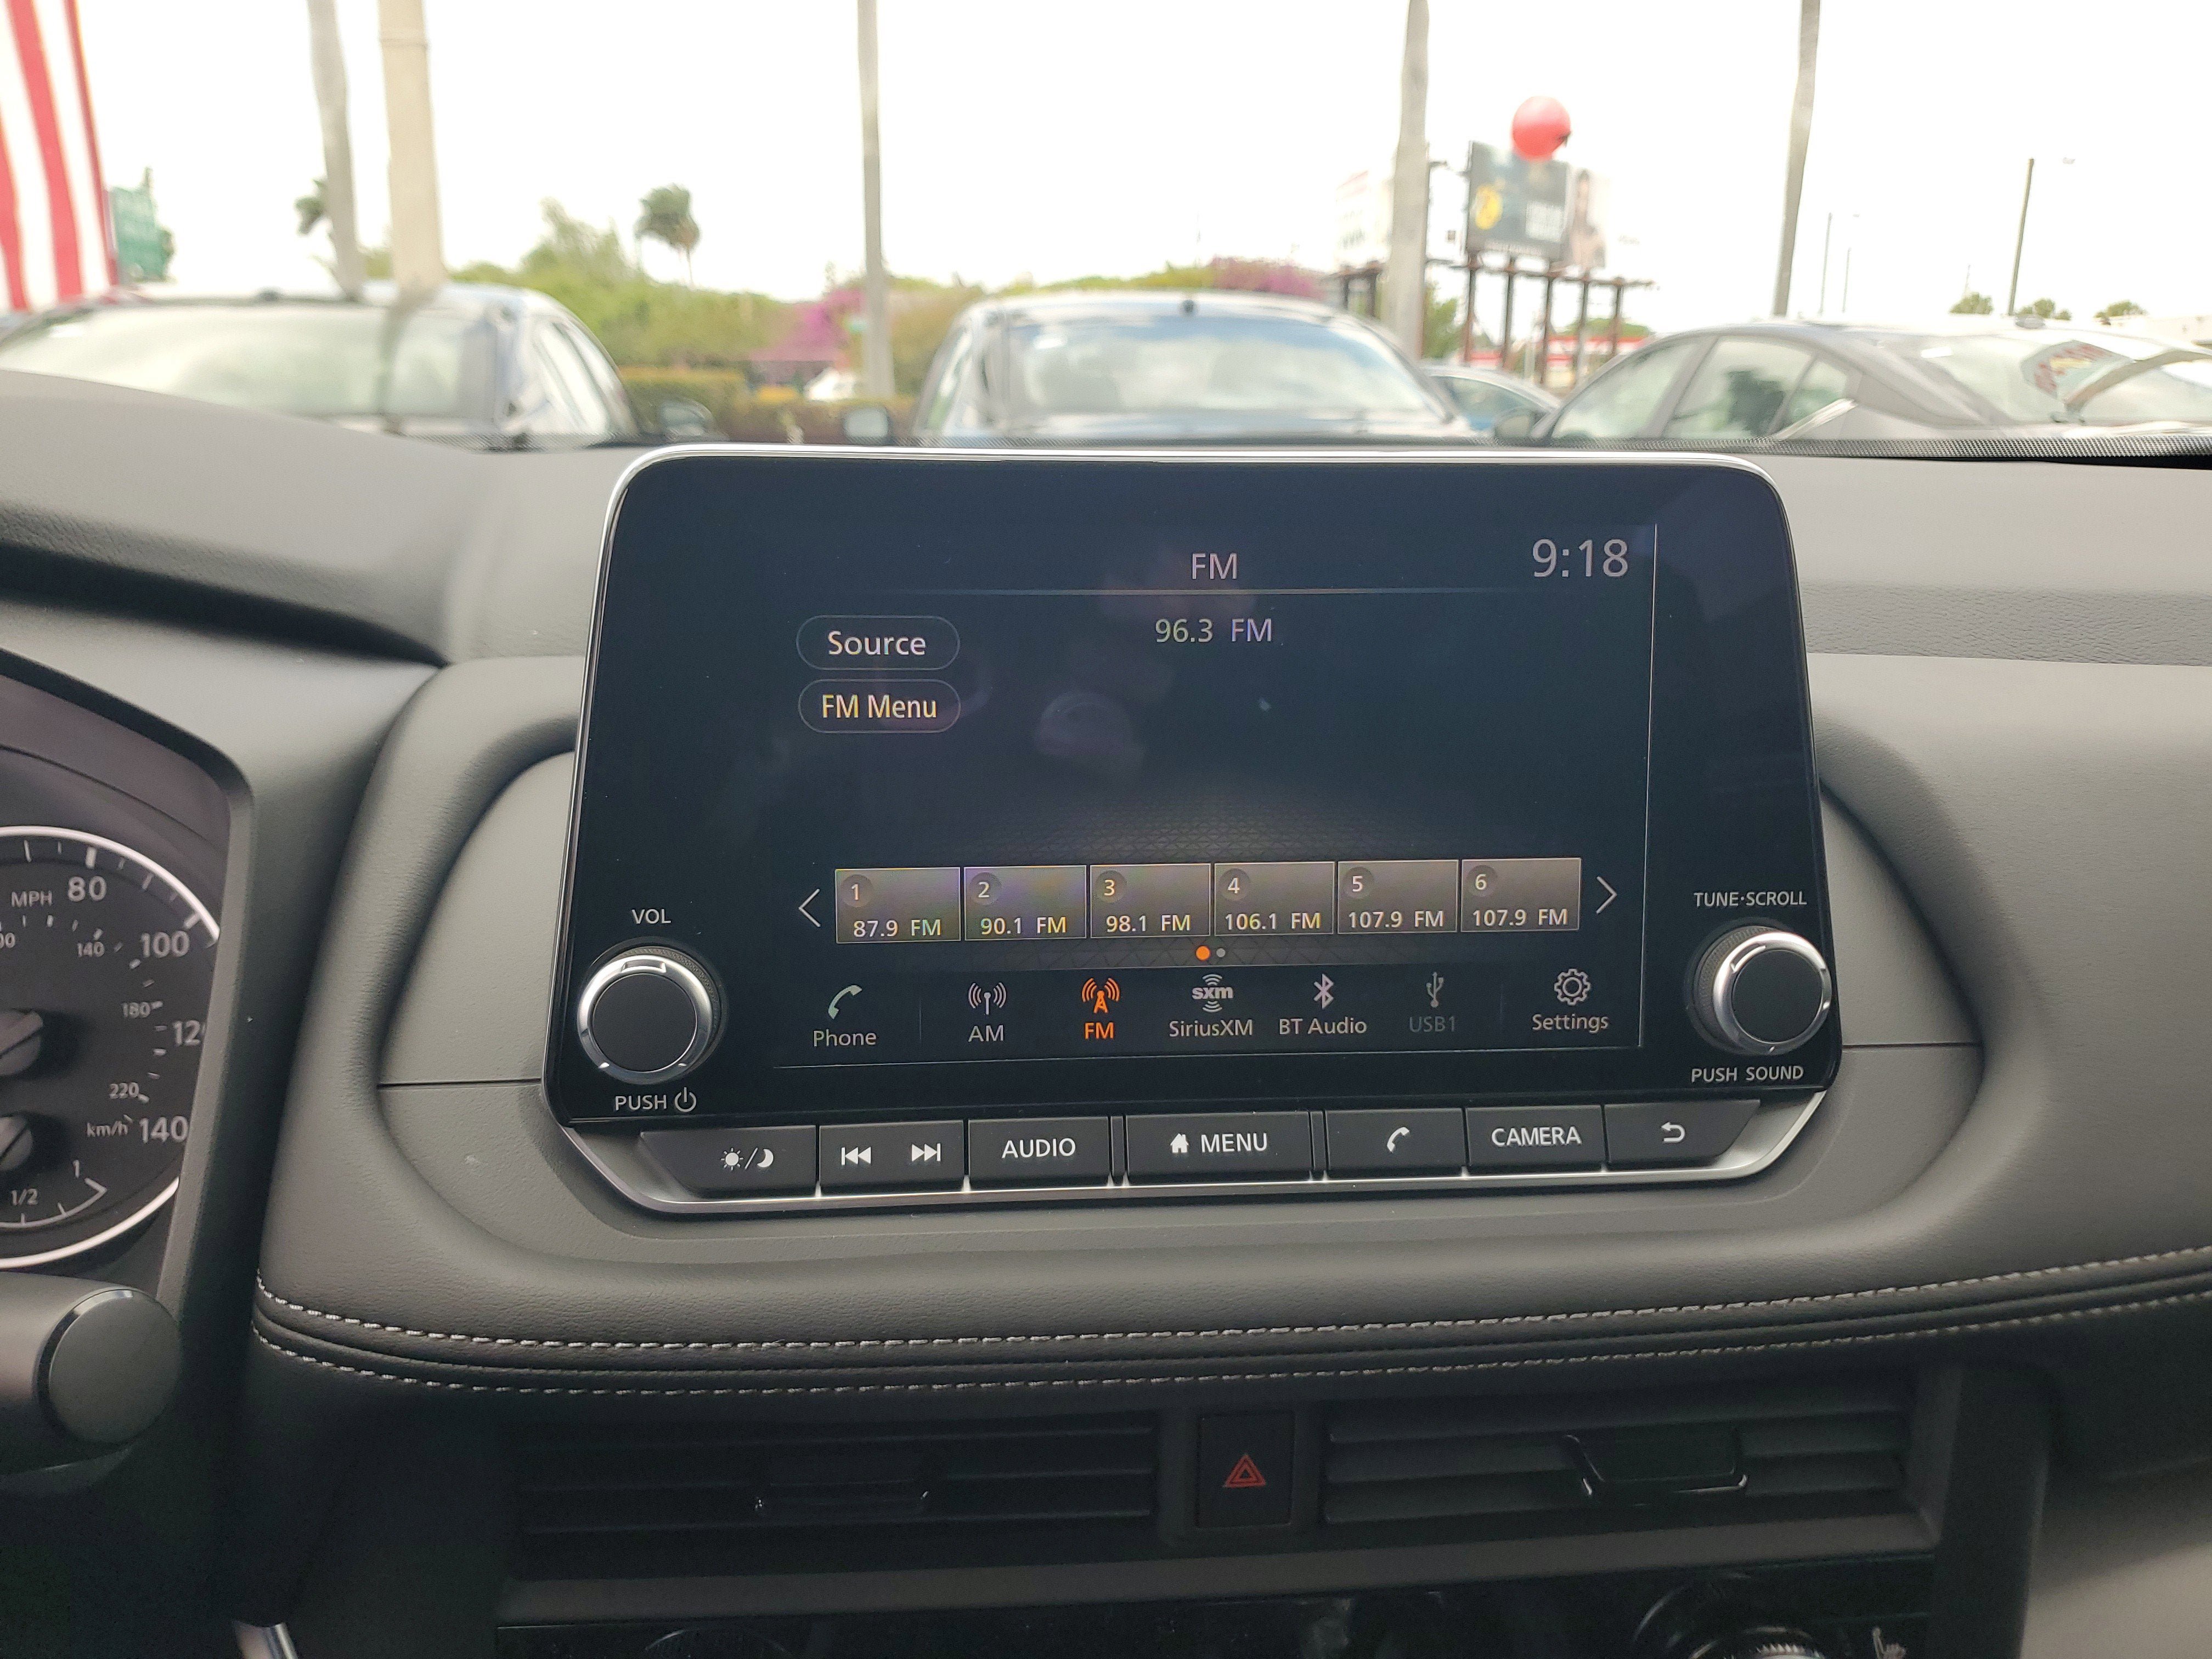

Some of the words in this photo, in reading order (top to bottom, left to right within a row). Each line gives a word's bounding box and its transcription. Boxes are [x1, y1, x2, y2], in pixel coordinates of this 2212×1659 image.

[1192, 553, 1237, 579] FM
[1532, 539, 1628, 577] 9:18
[1155, 618, 1212, 642] 96.3
[1232, 618, 1272, 642] FM
[828, 630, 926, 655] Source
[822, 695, 859, 718] FM
[868, 695, 936, 718] Menu
[67, 876, 106, 901] 80
[978, 882, 990, 898] 2
[1104, 879, 1115, 896] 3
[1228, 877, 1240, 894] 4
[1352, 876, 1363, 892] 5
[1475, 874, 1487, 890] 6
[12, 890, 52, 907] MPH
[851, 884, 859, 900] 1
[631, 909, 672, 924] VOL
[1106, 915, 1146, 932] 98.1
[1161, 915, 1190, 931] FM
[1225, 913, 1276, 930] 106.1
[1291, 912, 1321, 929] FM
[1348, 911, 1403, 928] 107.9
[1415, 910, 1444, 927] FM
[1473, 909, 1527, 926] 107.9
[1538, 909, 1567, 926] FM
[854, 920, 898, 937] 87.9
[911, 919, 941, 936] FM
[980, 917, 1021, 935] 90.1
[1037, 917, 1066, 934] FM
[77, 941, 105, 957] 140
[140, 930, 190, 958] 100
[122, 1002, 151, 1018] 180
[1085, 1022, 1114, 1039] FM
[1169, 1019, 1252, 1037] SiriusXM
[1279, 1018, 1303, 1035] BT
[1307, 1016, 1367, 1034] Audio
[1409, 1015, 1455, 1032] USB1
[1532, 1013, 1609, 1034] Settings
[172, 1020, 206, 1046] 12
[814, 1029, 877, 1047] Phone
[968, 1025, 1003, 1042] AM
[1691, 1067, 1737, 1082] PUSH
[1746, 1065, 1804, 1081] SOUND
[109, 1082, 139, 1099] 220
[615, 1094, 667, 1111] PUSH
[86, 1121, 128, 1137] km/h
[139, 1115, 188, 1143] 140
[1491, 1126, 1582, 1147] CAMERA
[1002, 1138, 1076, 1159] AUDIO
[1201, 1133, 1267, 1153] MENU
[72, 1159, 80, 1178] 1
[12, 1188, 38, 1205] 1/2
